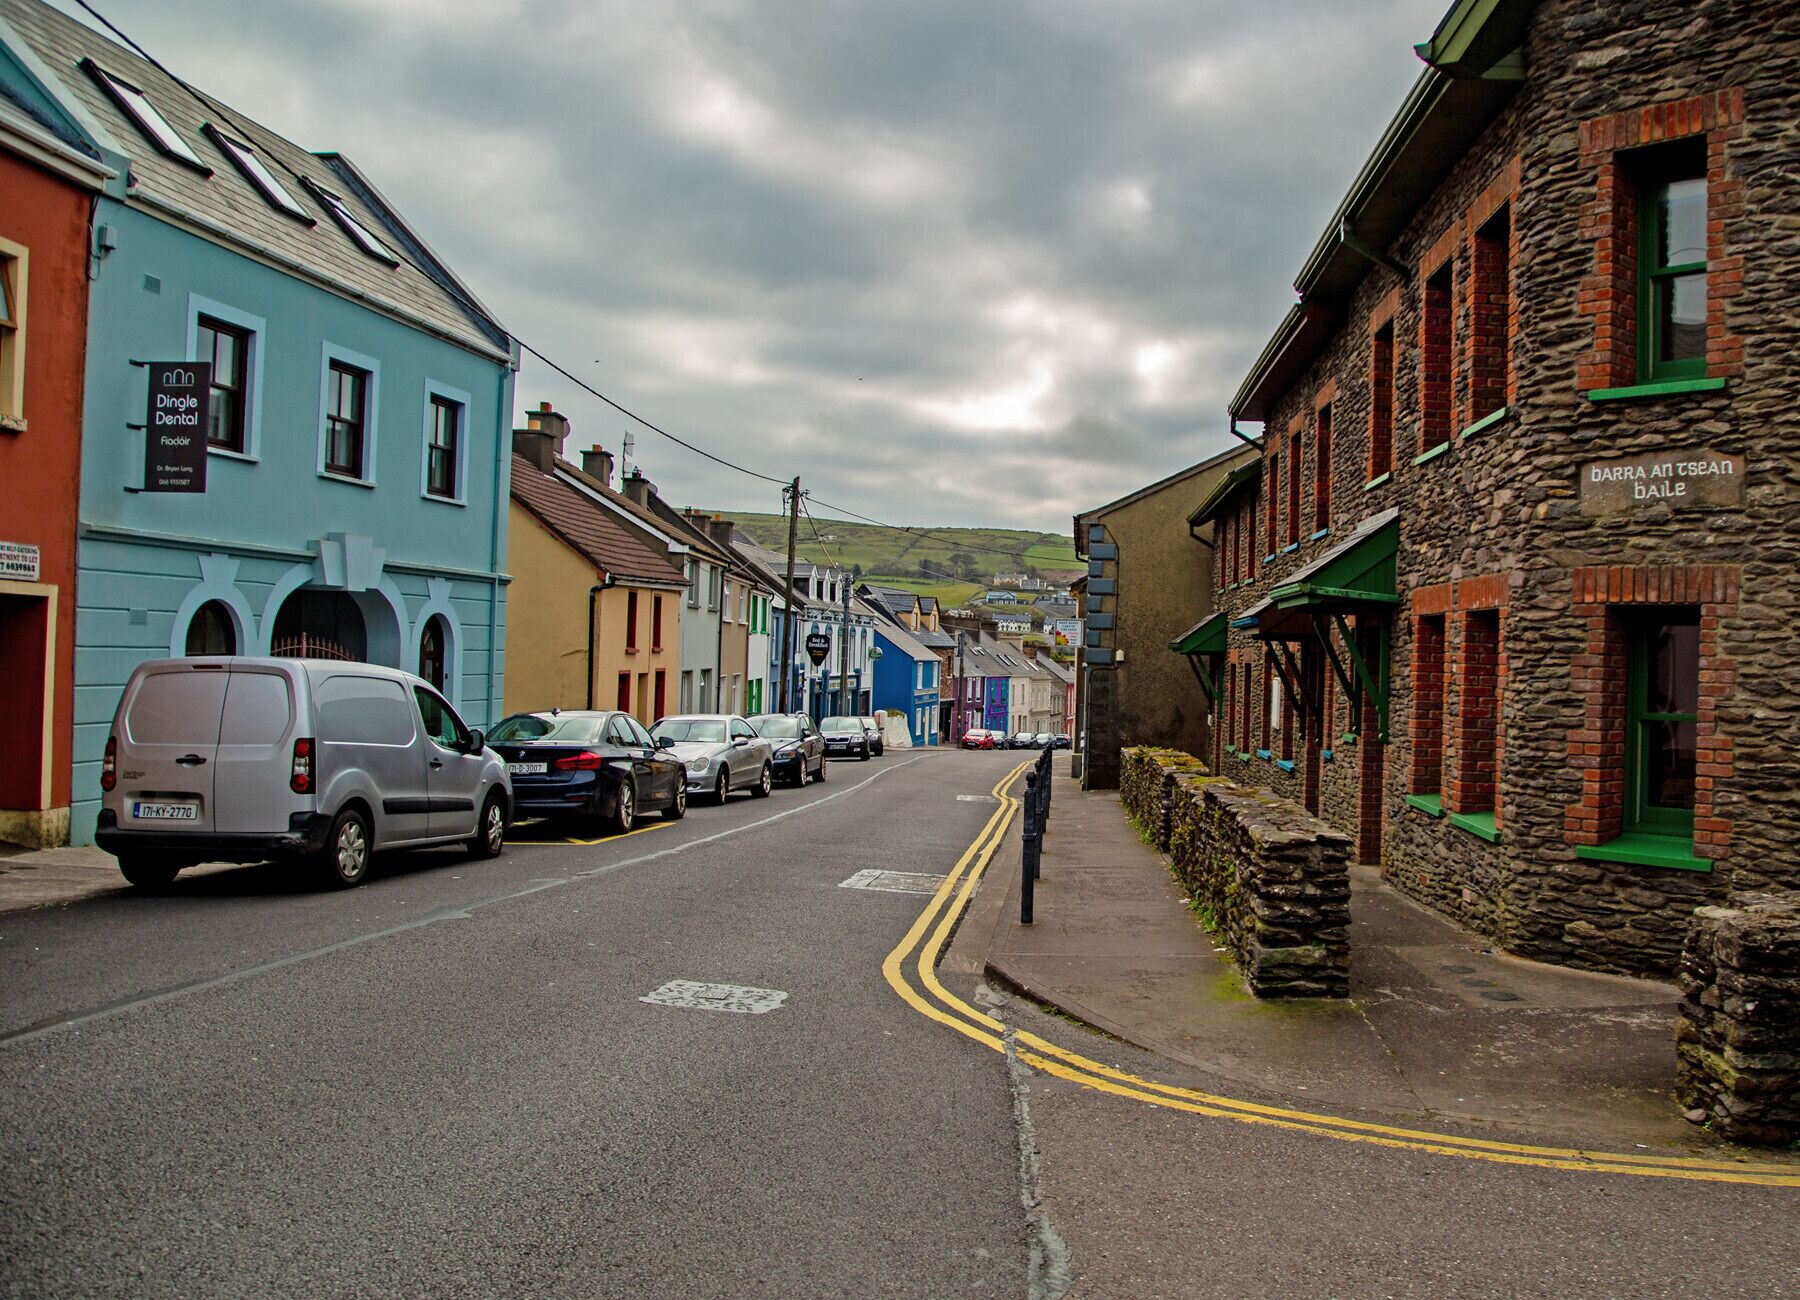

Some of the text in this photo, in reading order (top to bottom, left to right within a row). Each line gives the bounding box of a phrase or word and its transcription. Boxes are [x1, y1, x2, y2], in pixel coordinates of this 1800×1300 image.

[157, 394, 198, 411] Dingle
[156, 411, 198, 425] Dental
[143, 806, 192, 818] 171-KY-2770
